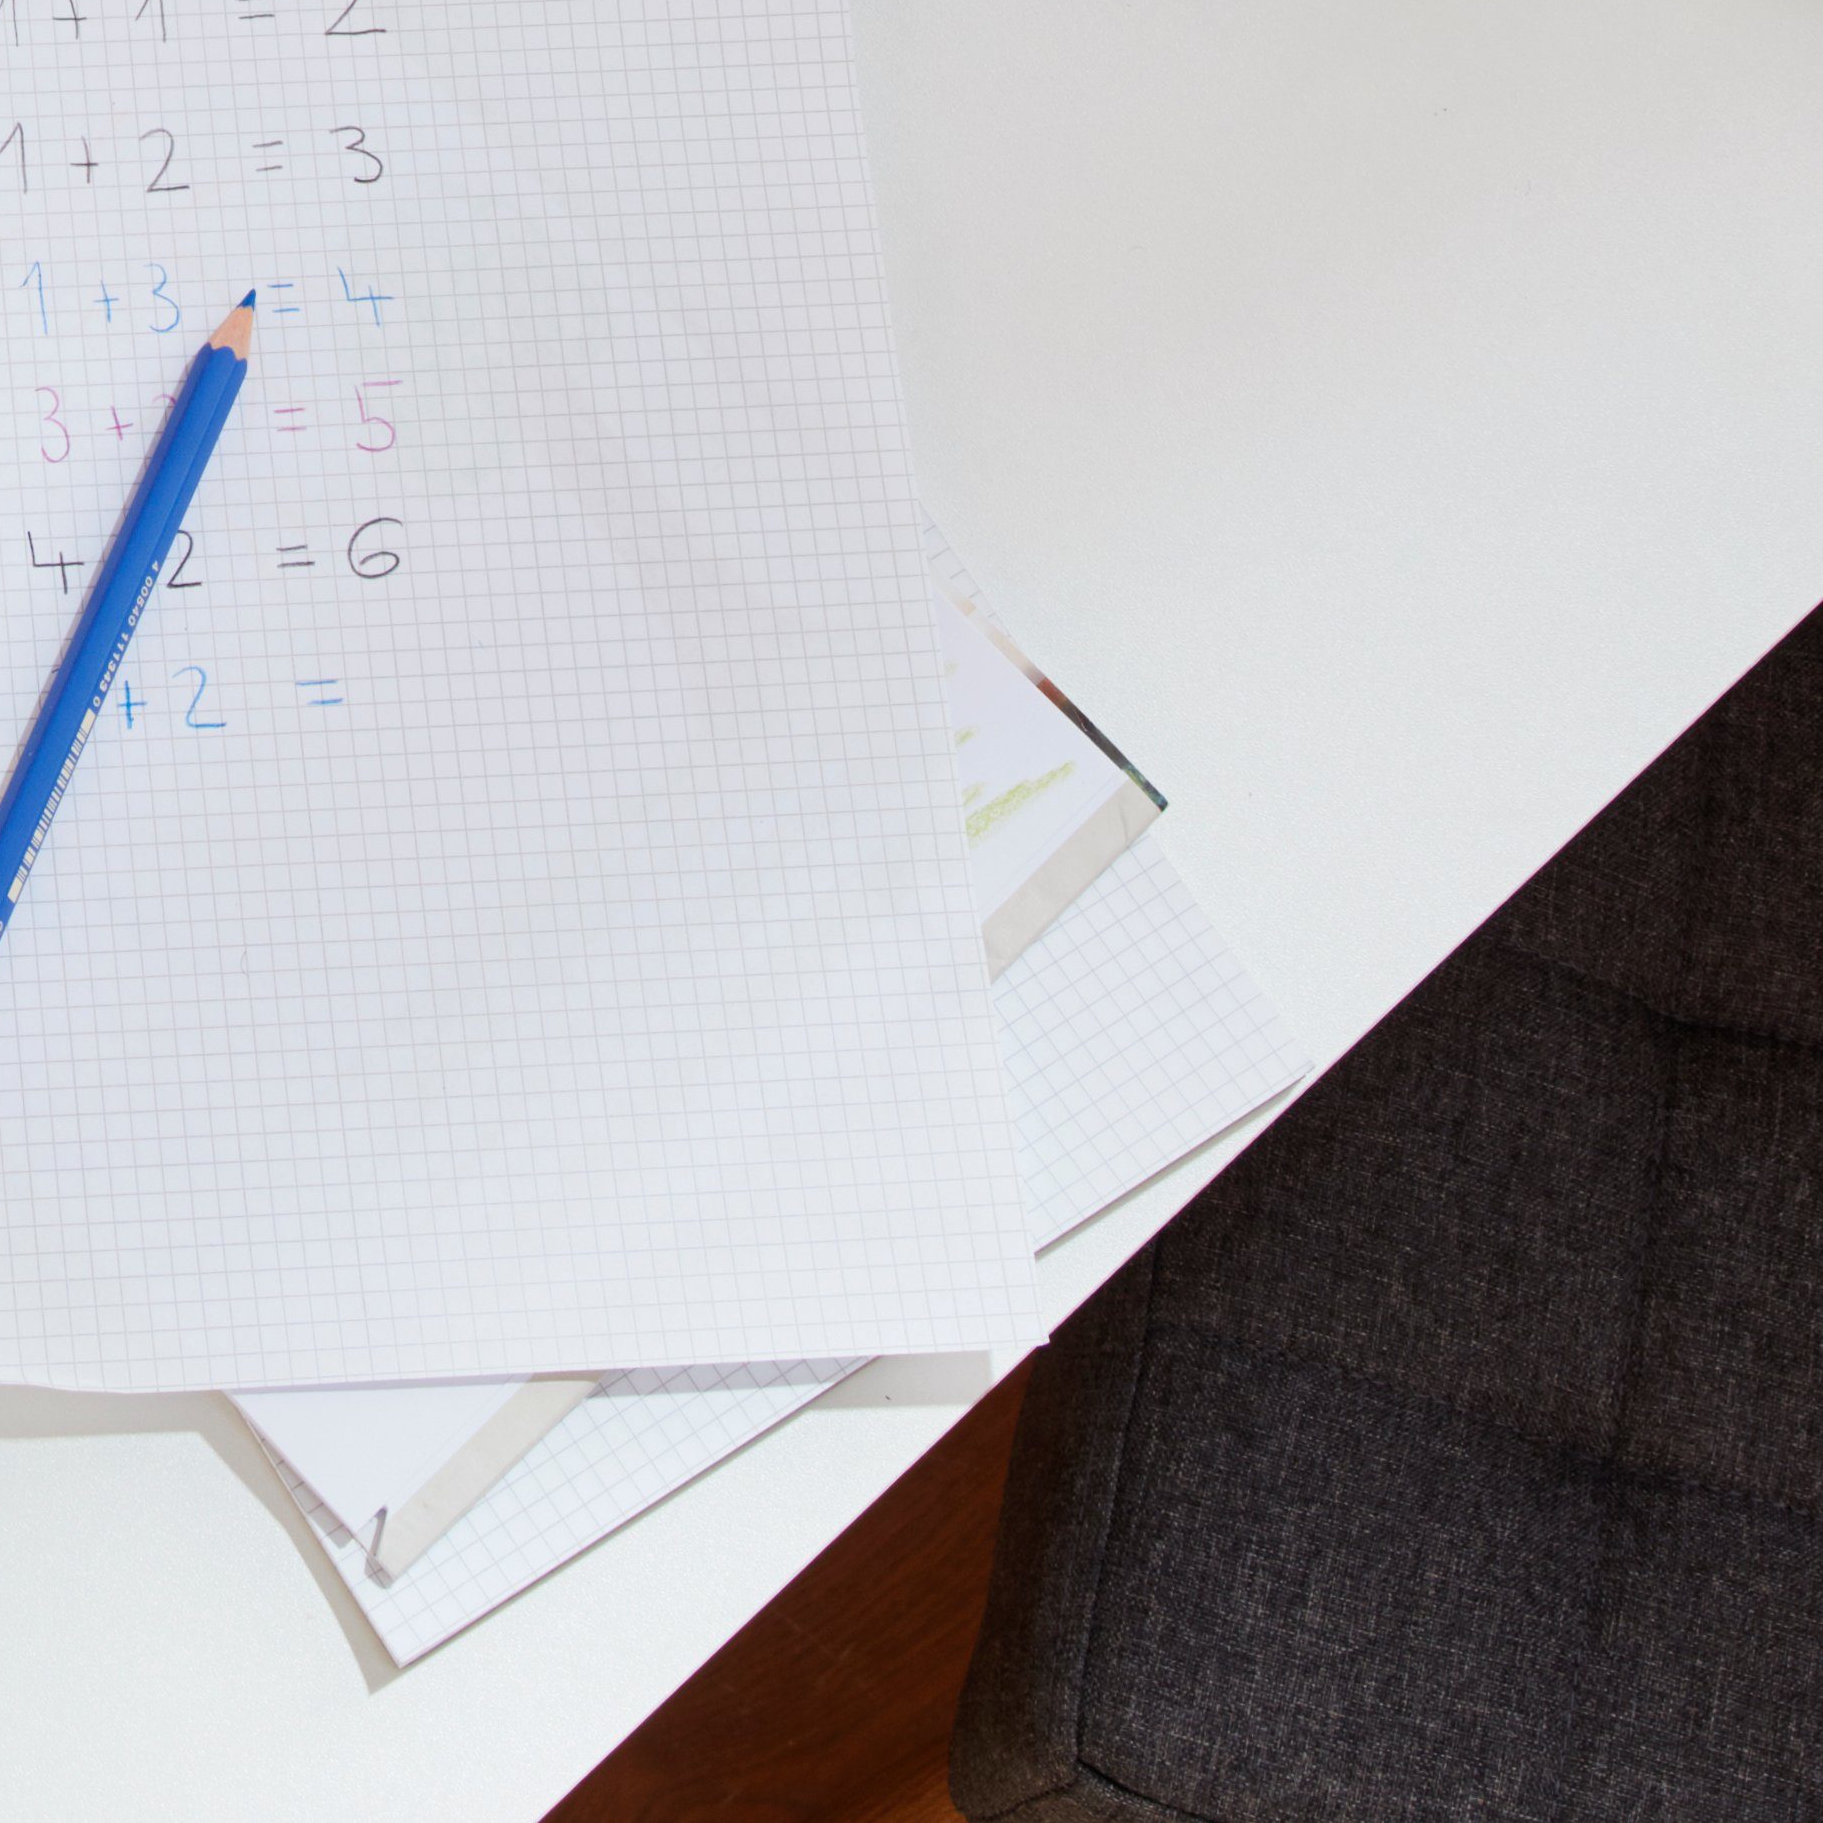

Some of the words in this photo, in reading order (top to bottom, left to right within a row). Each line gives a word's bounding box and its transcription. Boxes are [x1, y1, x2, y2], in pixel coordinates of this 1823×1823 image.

[139, 128, 191, 193] 2
[329, 125, 384, 185] 3
[22, 260, 49, 336] 1
[145, 262, 182, 334] 3
[337, 267, 395, 328] 4
[34, 385, 72, 464] 3
[354, 380, 405, 453] 5
[26, 530, 86, 595] 4
[166, 529, 203, 590] 2
[347, 516, 405, 580] 6
[152, 559, 160, 572] 4
[127, 575, 154, 627] 00540
[99, 632, 130, 693] 111343
[92, 695, 102, 708] 0
[171, 664, 228, 730] 2
